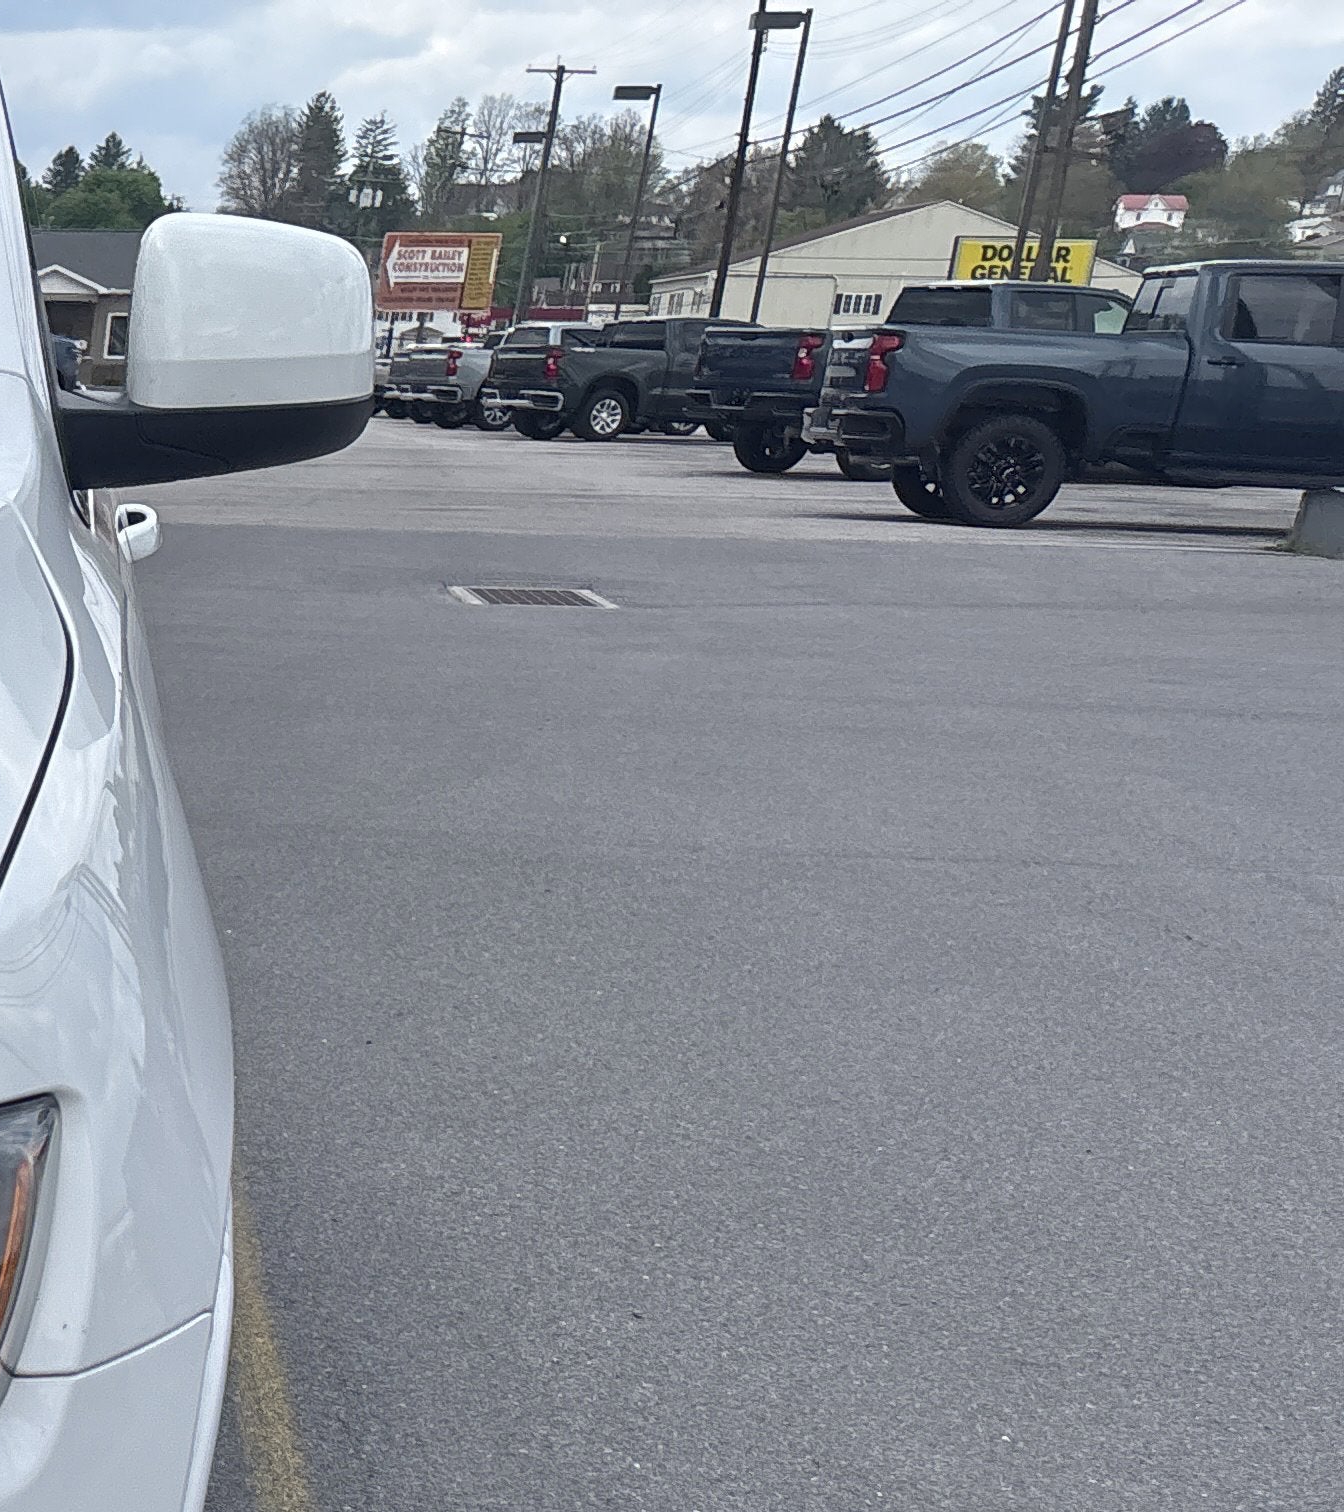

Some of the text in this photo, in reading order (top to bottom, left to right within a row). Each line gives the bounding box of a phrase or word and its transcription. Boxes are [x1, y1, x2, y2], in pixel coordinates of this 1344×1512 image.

[396, 249, 427, 260] SCOTT
[981, 244, 1071, 263] DOLR
[392, 261, 464, 273] CONSTRUCTION
[970, 264, 1072, 283] GENEAL
